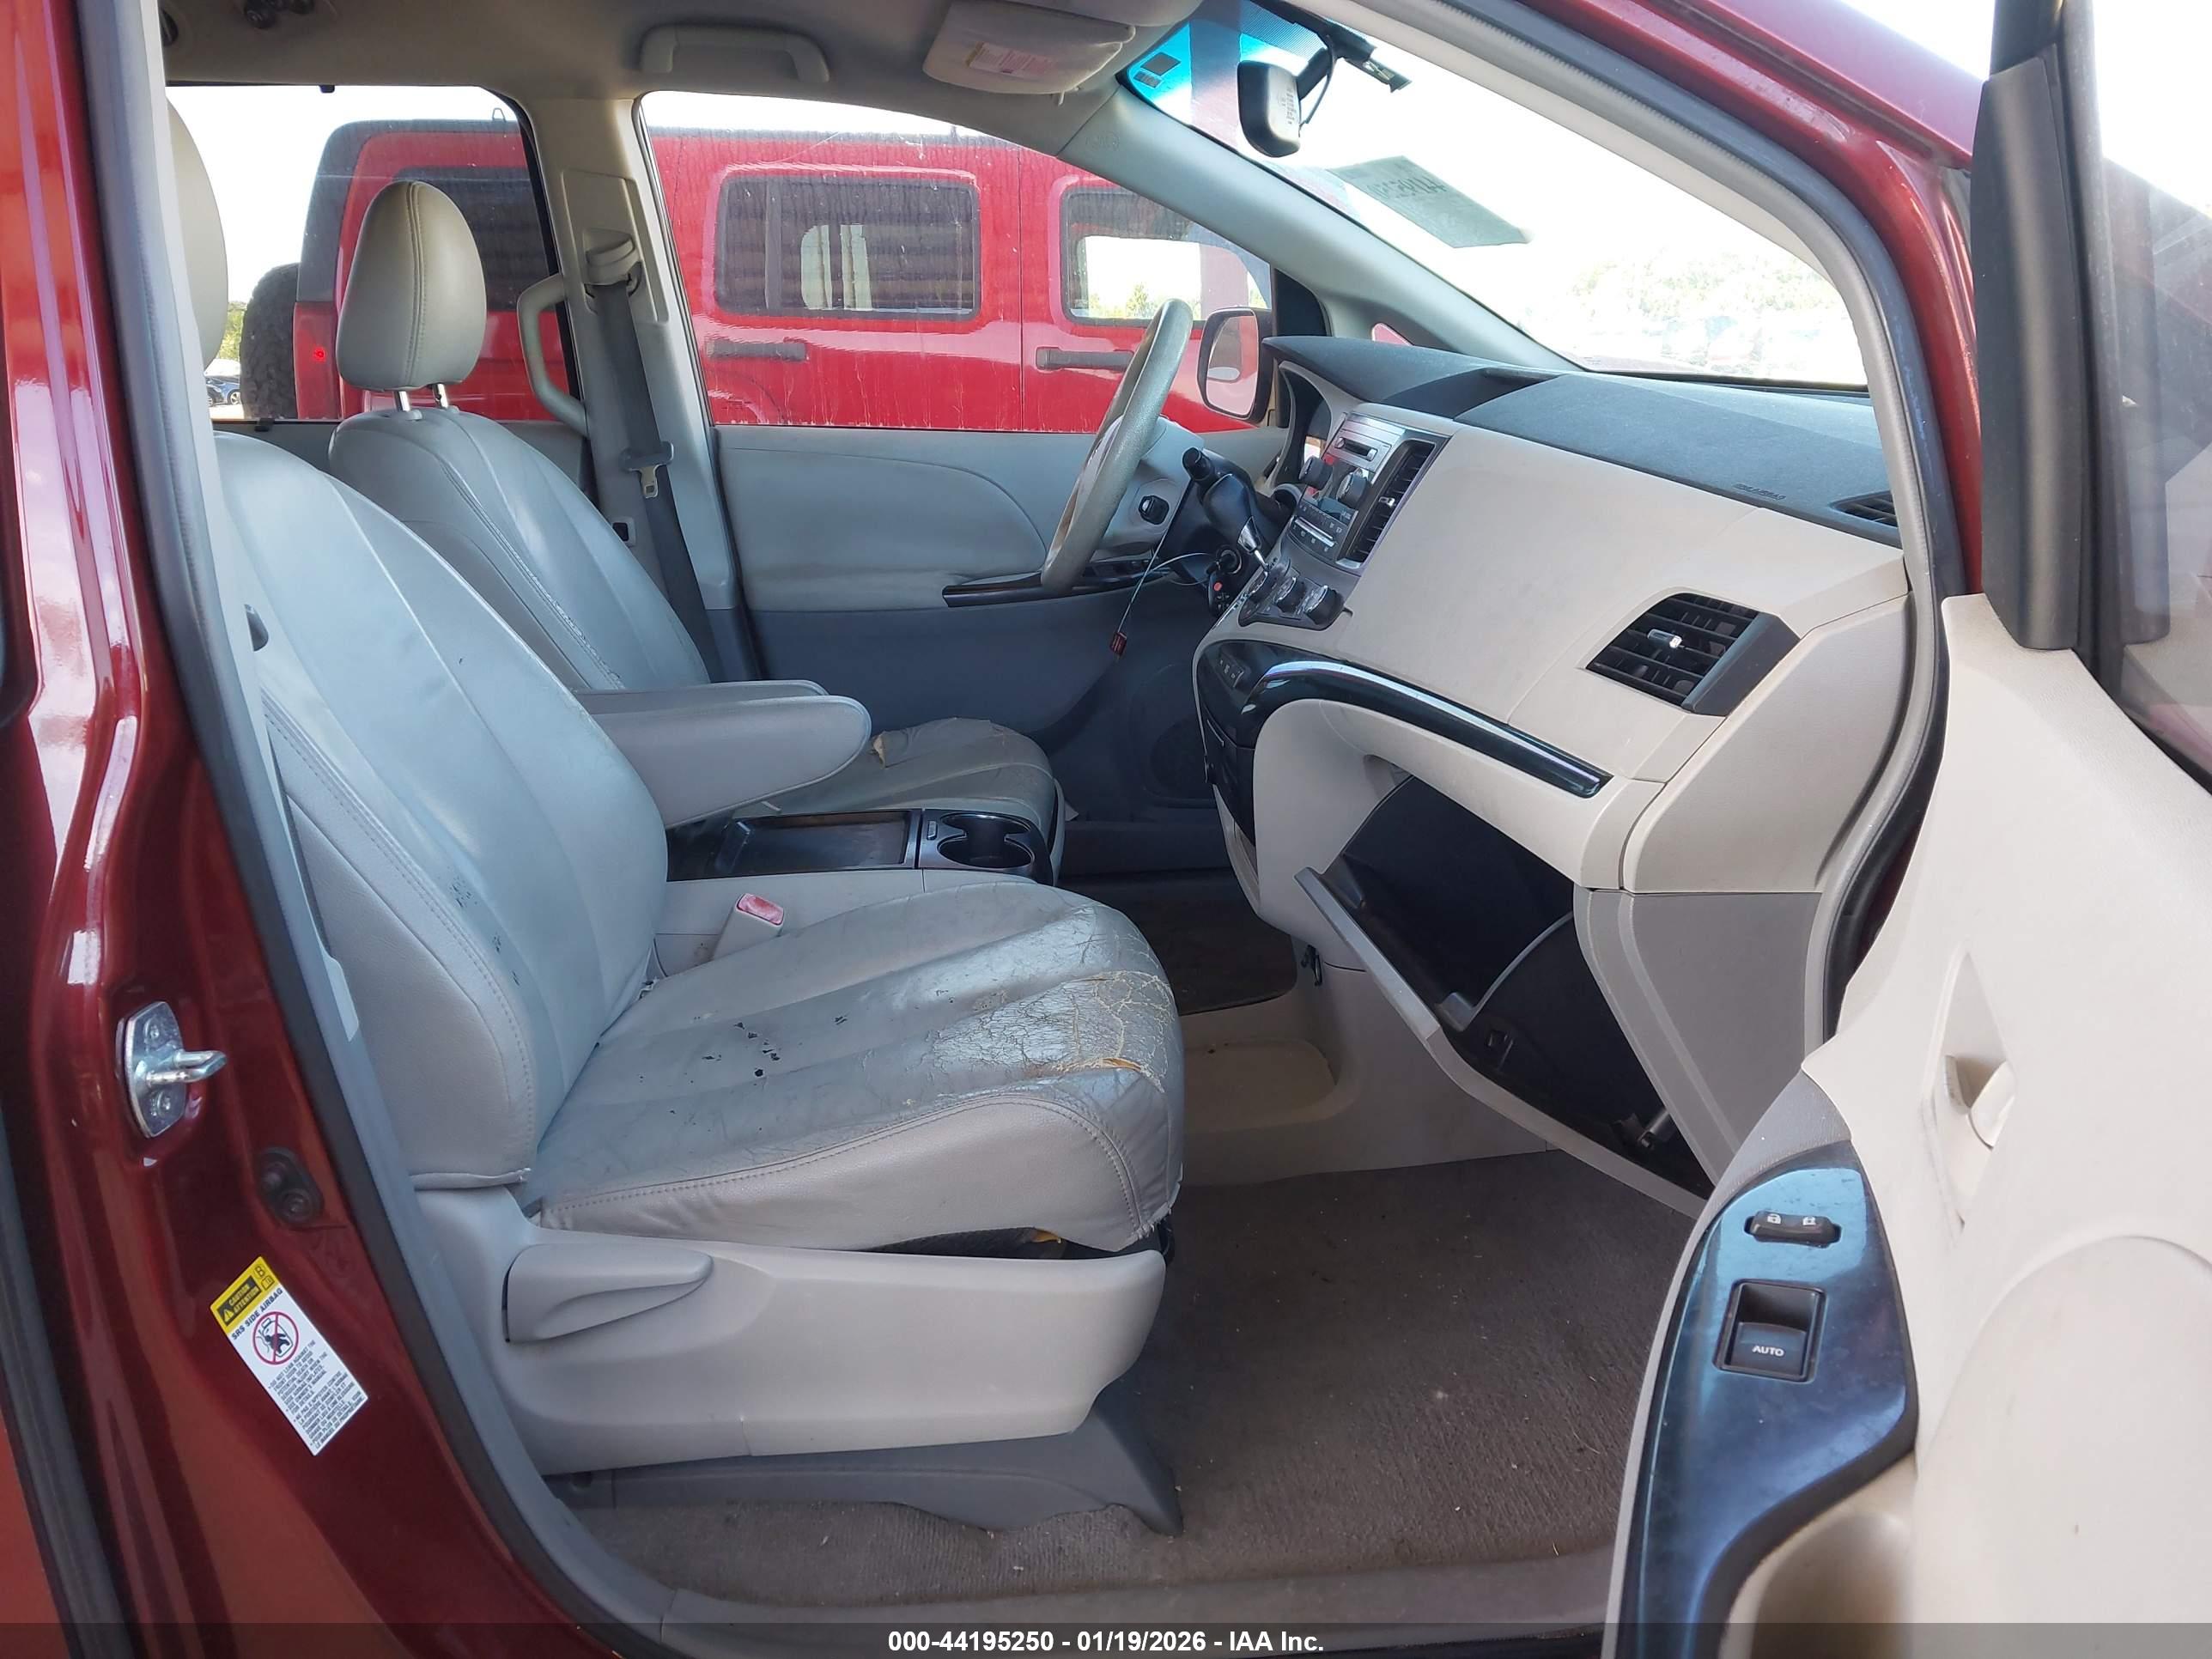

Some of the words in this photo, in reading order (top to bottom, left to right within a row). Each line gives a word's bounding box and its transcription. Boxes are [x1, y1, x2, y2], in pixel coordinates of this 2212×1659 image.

[255, 1266, 265, 1278] B
[232, 1325, 246, 1340] SRS
[245, 1310, 260, 1327] SIDE
[260, 1287, 283, 1312] AIRBAG
[1752, 1345, 1784, 1357] AUTO
